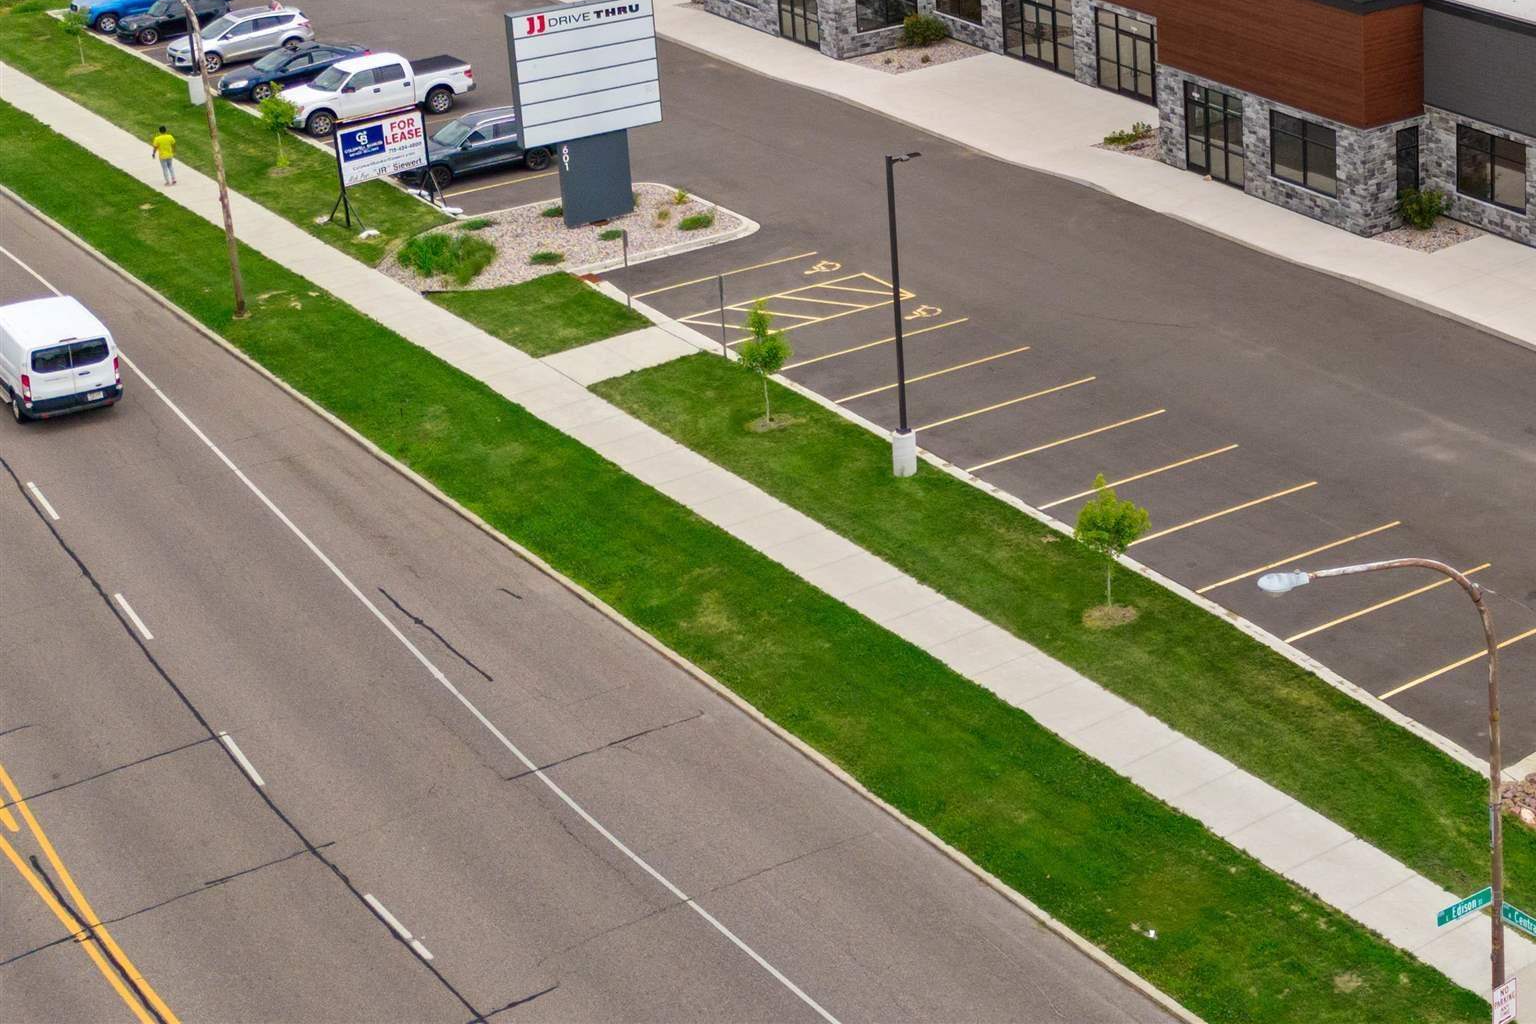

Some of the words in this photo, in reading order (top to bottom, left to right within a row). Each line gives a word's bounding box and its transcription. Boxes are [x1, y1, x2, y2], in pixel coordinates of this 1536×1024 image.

[526, 15, 546, 35] JJ
[548, 11, 591, 27] DRIVE
[592, 3, 640, 19] THRU
[390, 118, 415, 132] FOR
[385, 128, 422, 145] LEASE
[393, 158, 422, 171] Siewert
[1452, 899, 1477, 918] Edison
[1500, 986, 1509, 996] NO
[1494, 992, 1515, 1009] PARKING
